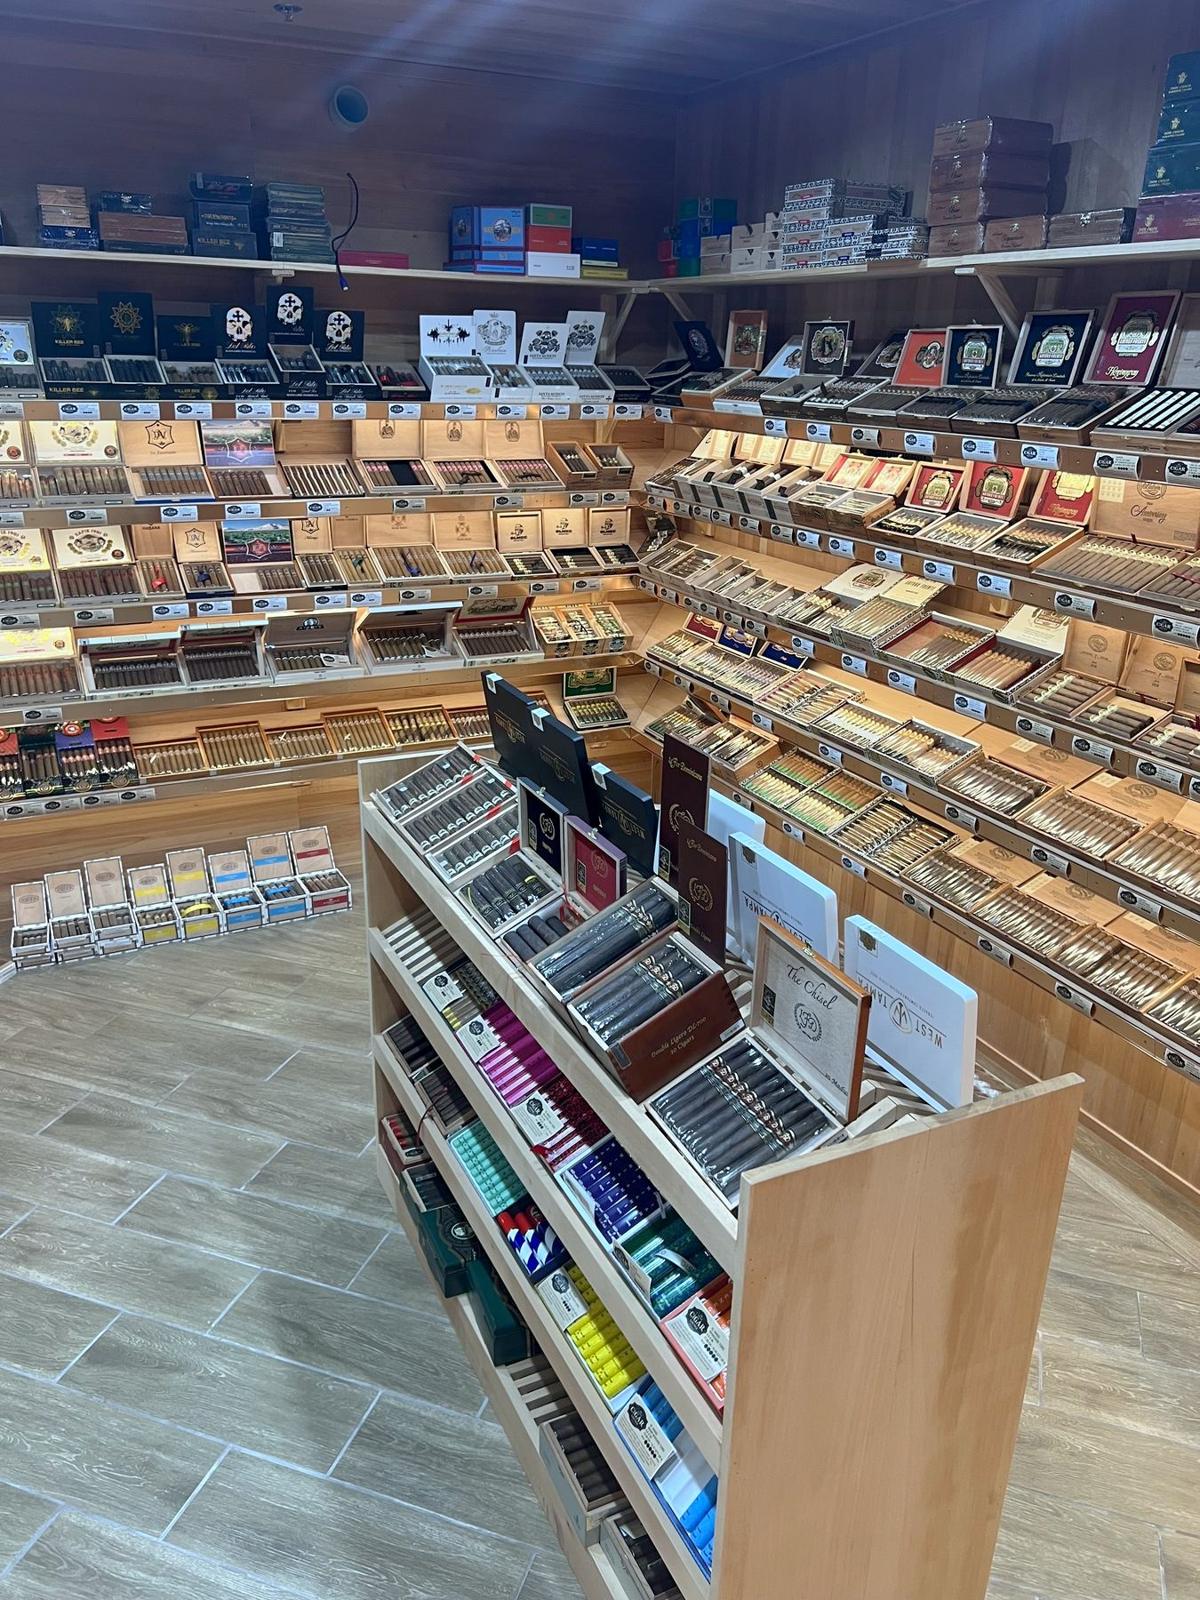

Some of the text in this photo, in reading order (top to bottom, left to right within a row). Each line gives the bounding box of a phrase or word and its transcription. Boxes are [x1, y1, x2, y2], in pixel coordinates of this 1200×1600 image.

[786, 964, 805, 986] The
[804, 980, 837, 1010] Chisel
[916, 1019, 943, 1049] WEST
[688, 1310, 706, 1332] CIGAR
[629, 1405, 646, 1427] CIGAR
